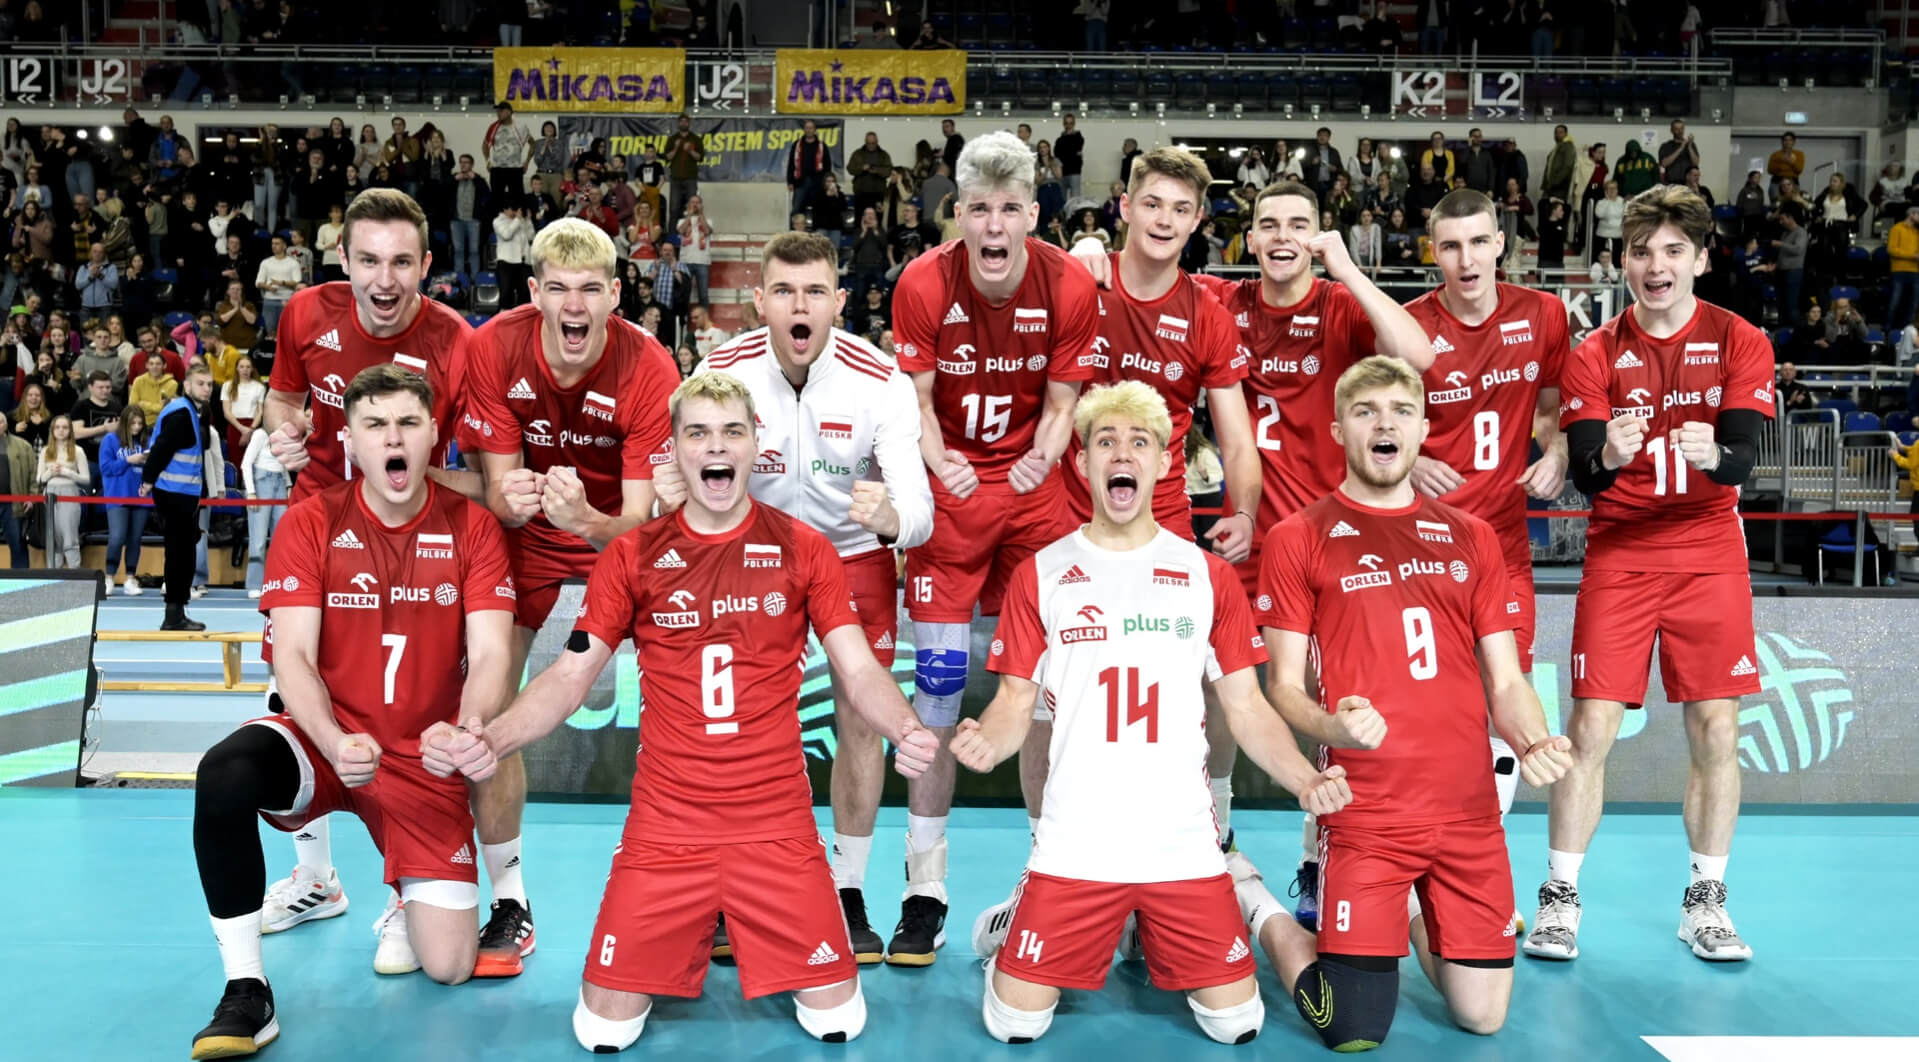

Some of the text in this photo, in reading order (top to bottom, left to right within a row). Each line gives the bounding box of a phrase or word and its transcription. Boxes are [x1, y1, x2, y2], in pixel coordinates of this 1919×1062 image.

[82, 59, 126, 94] J2
[700, 64, 744, 99] J2
[1394, 71, 1445, 106] K2
[1474, 71, 1520, 106] L2
[1562, 288, 1611, 328] K1
[986, 356, 1023, 373] plus
[1121, 352, 1162, 374] plus
[1261, 356, 1298, 375] plus
[1481, 368, 1520, 391] plus
[1431, 389, 1469, 402] ORLEN
[1663, 389, 1701, 411] plus
[961, 393, 1013, 443] 15
[1257, 395, 1281, 451] 2
[560, 429, 593, 448] plus
[819, 431, 853, 440] POLSKA
[1473, 411, 1500, 470] 8
[753, 464, 783, 473] RLEN
[811, 459, 851, 476] plus
[1646, 436, 1687, 497] 11
[332, 540, 365, 550] adidas
[416, 550, 454, 559] POLSKA
[653, 560, 687, 569] adidas
[743, 560, 782, 569] POLSKA
[1398, 557, 1446, 581] plus
[914, 576, 933, 603] 15
[1058, 575, 1092, 585] adidas
[1152, 577, 1190, 588] POLSKA
[1344, 573, 1389, 589] ORLEN
[330, 594, 377, 607] ORLEN
[390, 583, 430, 605] plus
[712, 594, 759, 619] plus
[655, 614, 696, 626] ORLEN
[1123, 613, 1170, 636] plus
[1062, 627, 1104, 642] ORLEN
[1402, 606, 1438, 681] 9
[381, 633, 407, 705] 7
[1573, 653, 1585, 679] 11
[701, 643, 735, 718] 6
[1098, 666, 1159, 743] 14
[1336, 900, 1351, 932] 9
[600, 933, 617, 967] 6
[1016, 929, 1044, 963] 14
[807, 953, 840, 966] adidas
